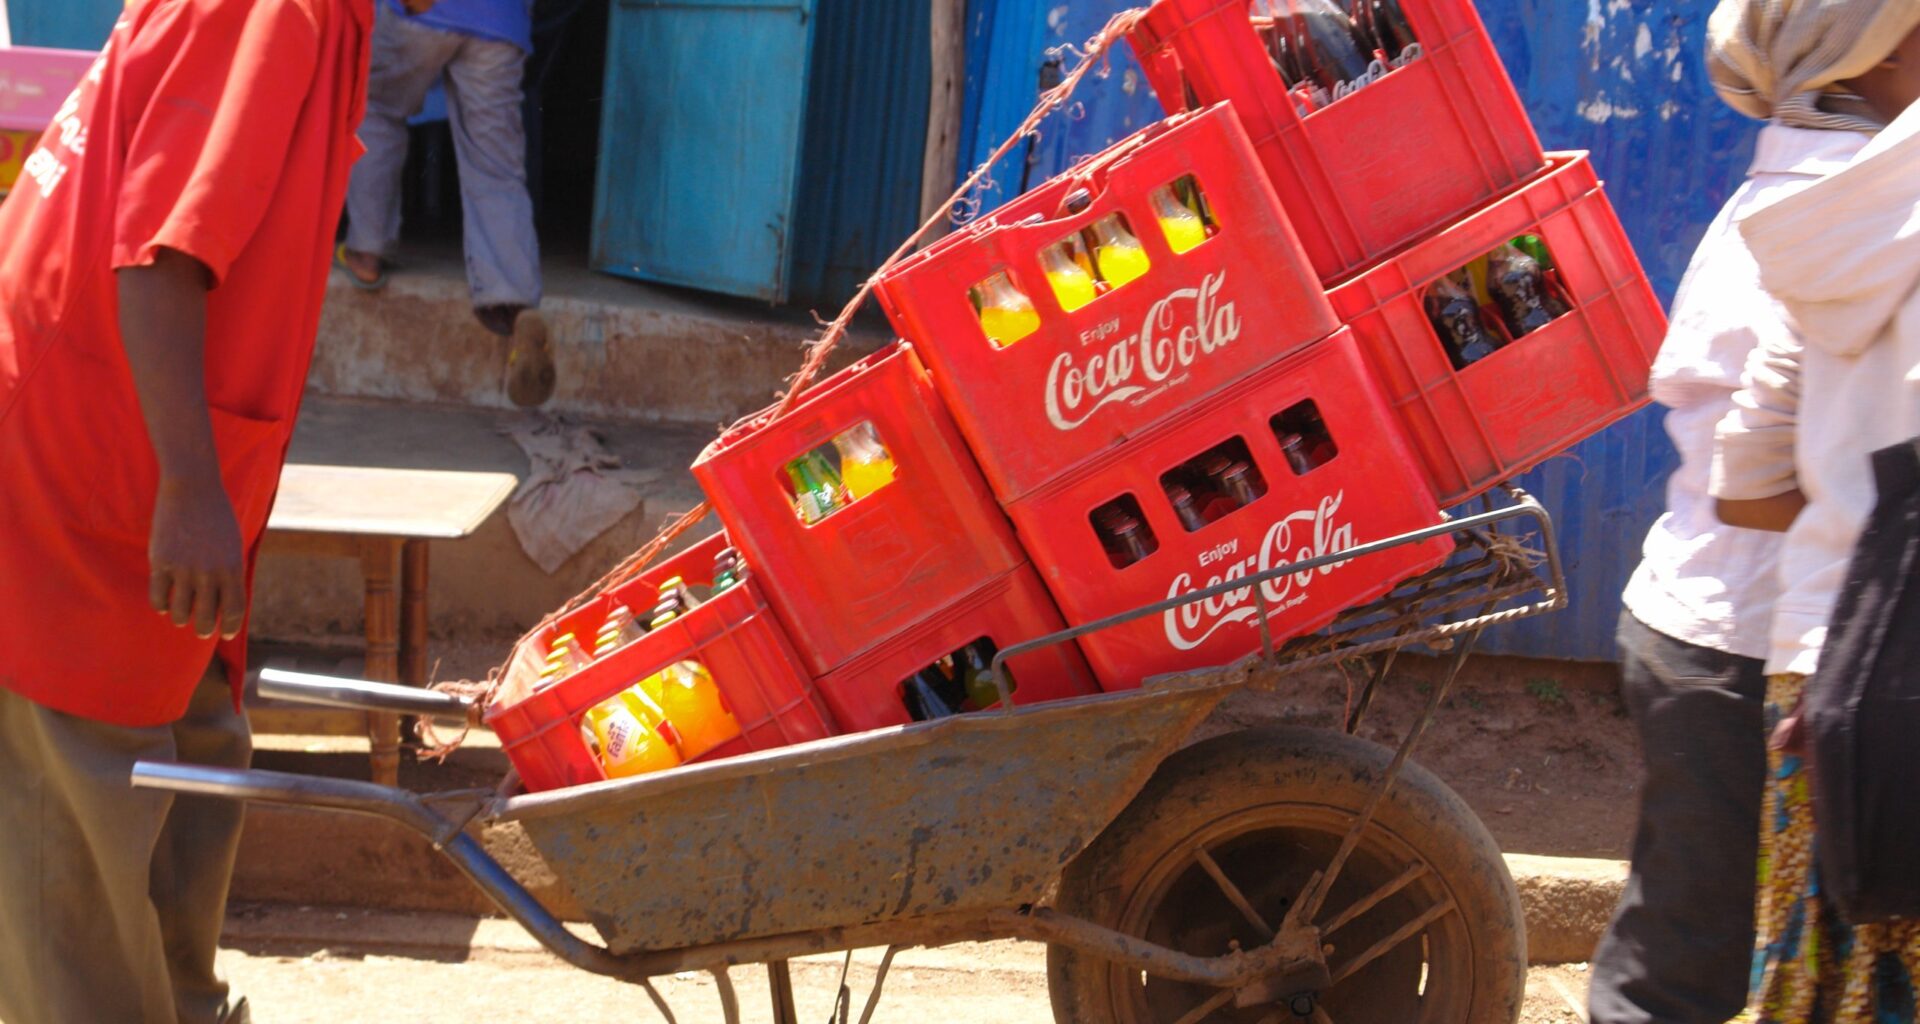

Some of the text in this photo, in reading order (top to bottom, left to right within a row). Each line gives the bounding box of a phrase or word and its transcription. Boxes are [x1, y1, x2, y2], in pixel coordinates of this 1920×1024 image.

[1045, 269, 1241, 430] Coca-Cola
[1080, 318, 1120, 346] Enjoy
[1164, 489, 1358, 650] Coca-Cola
[1198, 538, 1239, 567] Enjoy
